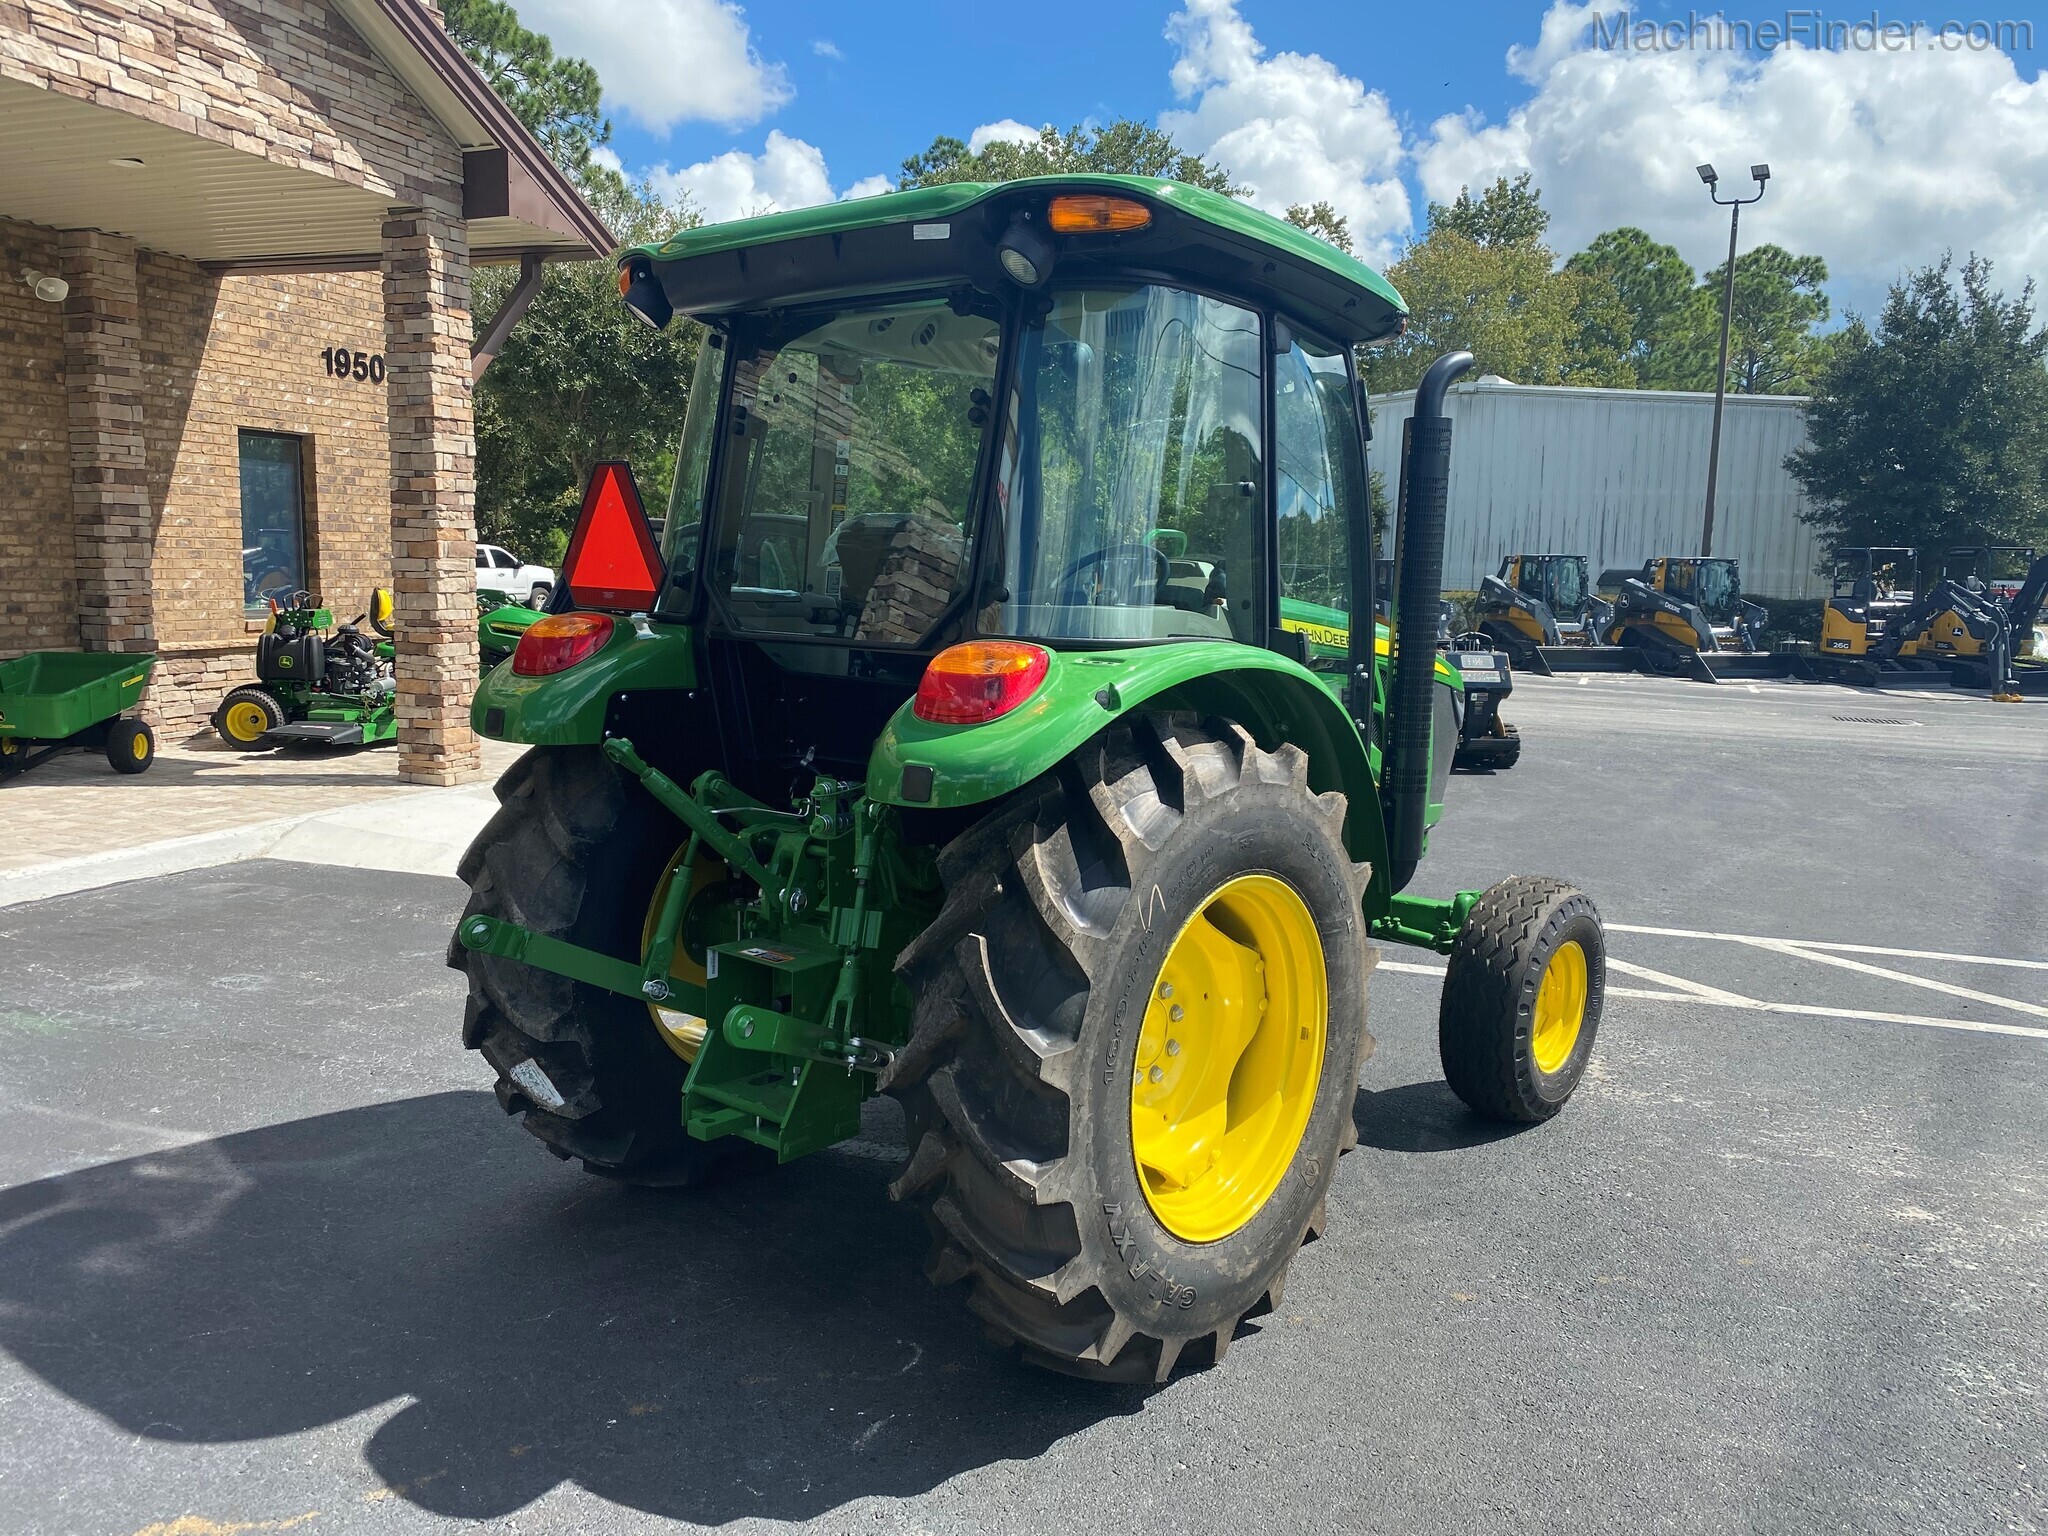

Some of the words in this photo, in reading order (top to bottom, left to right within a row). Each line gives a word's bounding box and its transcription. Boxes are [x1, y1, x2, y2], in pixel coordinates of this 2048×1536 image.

[321, 346, 385, 385] 1950
[1664, 601, 1681, 614] DEERE
[1951, 604, 1970, 618] DEERE
[1324, 630, 1349, 646] DEE
[1832, 642, 1850, 650] 26G
[1102, 1201, 1198, 1310] GALAXY
